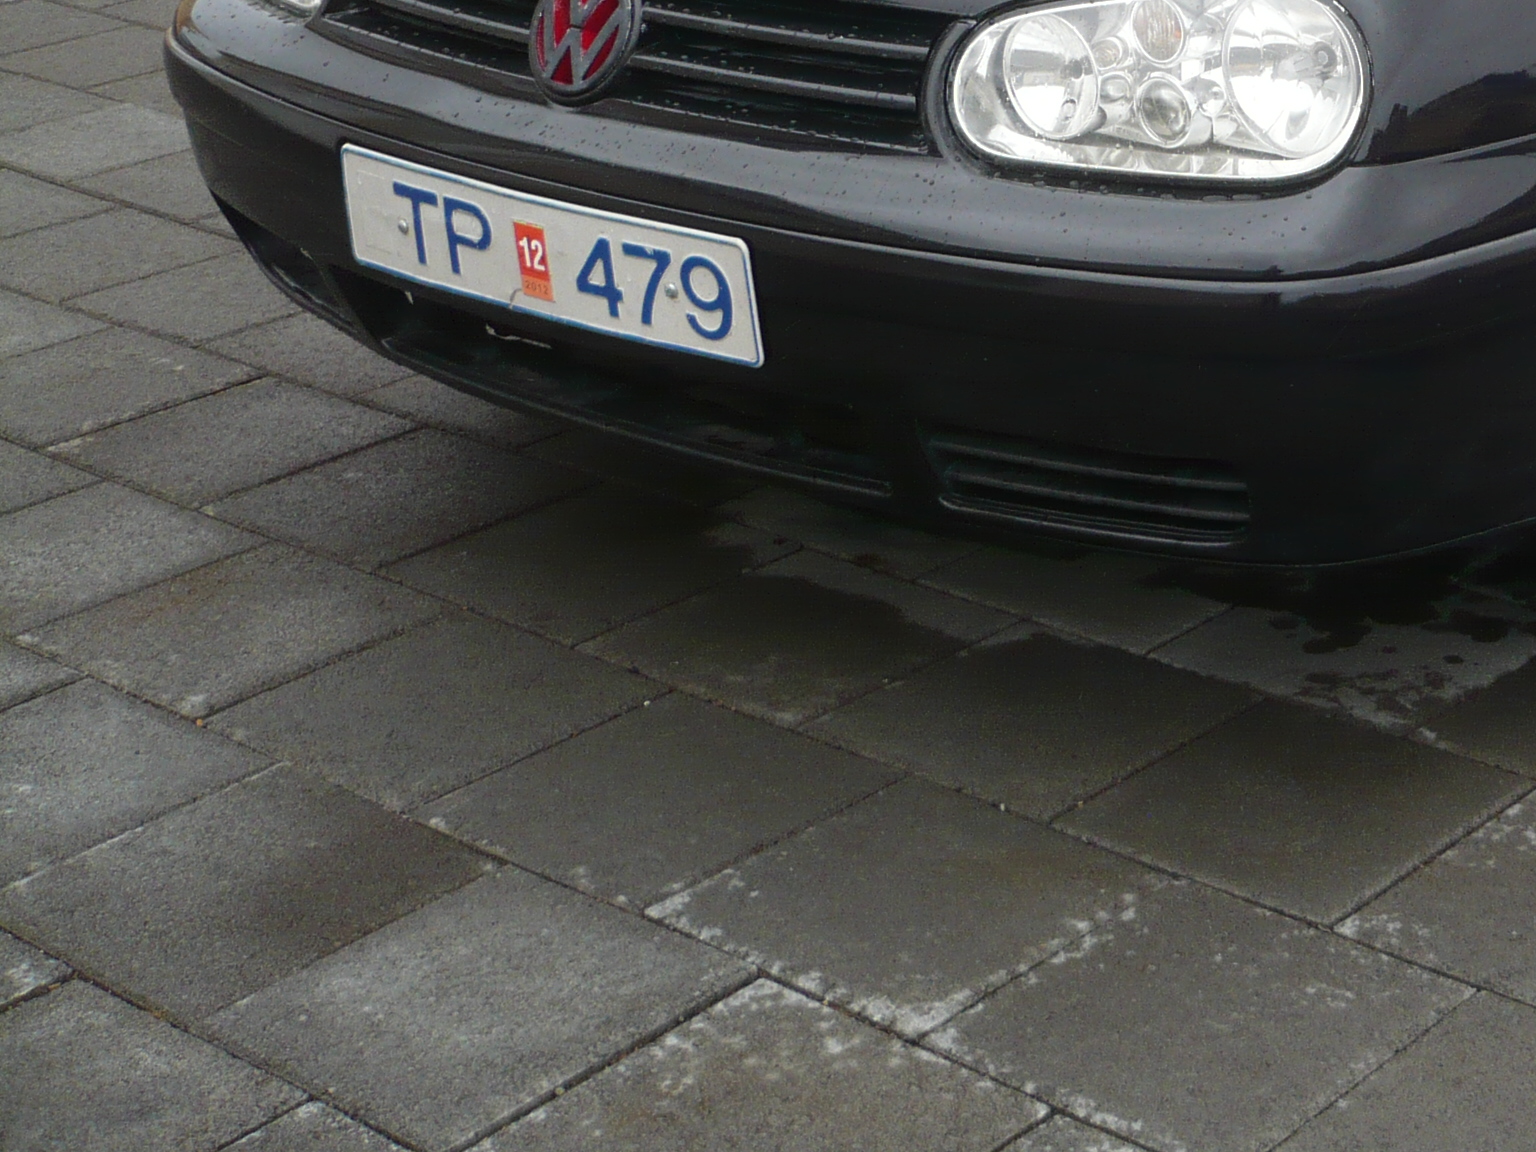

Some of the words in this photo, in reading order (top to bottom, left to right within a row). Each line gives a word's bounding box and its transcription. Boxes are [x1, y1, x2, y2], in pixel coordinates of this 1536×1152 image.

[392, 180, 493, 276] TP
[575, 236, 734, 342] 479
[518, 236, 546, 271] 12
[524, 279, 550, 296] 2012
